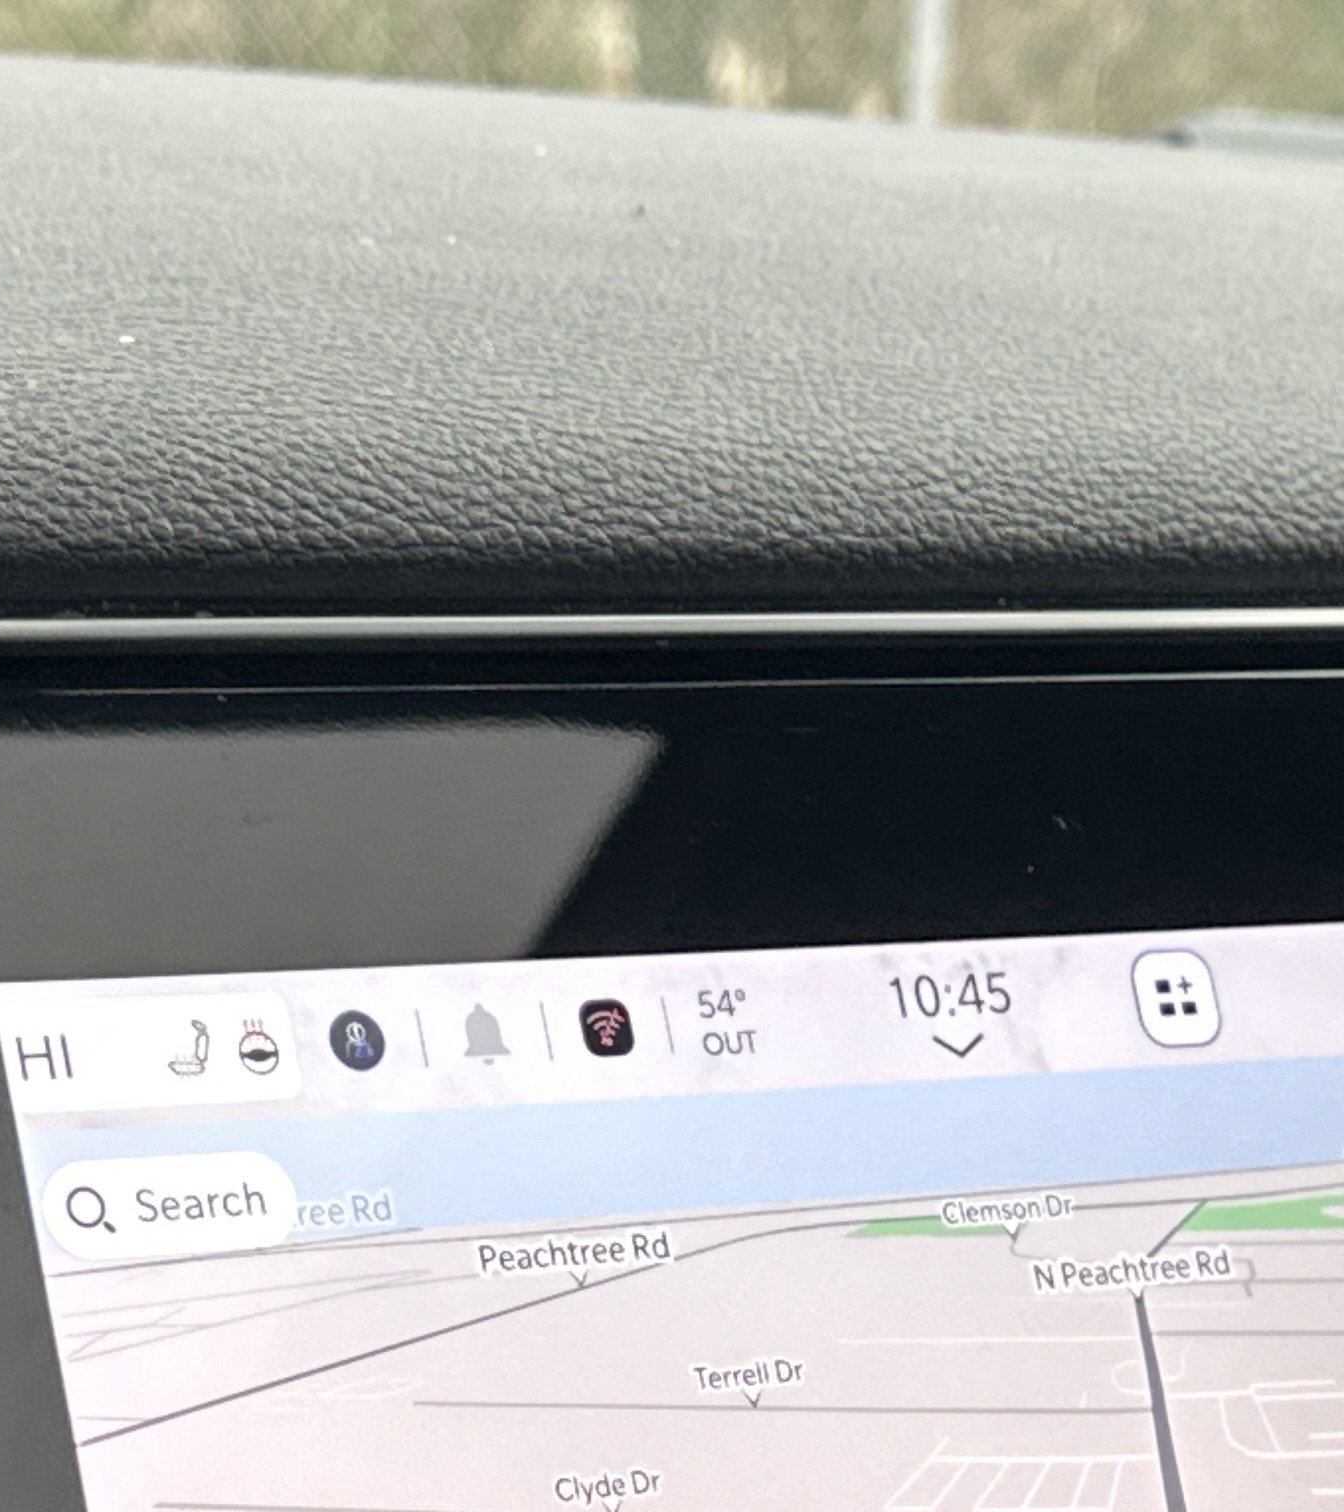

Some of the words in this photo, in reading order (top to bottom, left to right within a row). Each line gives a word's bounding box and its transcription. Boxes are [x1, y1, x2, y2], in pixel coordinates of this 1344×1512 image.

[889, 972, 1011, 1019] 10:45
[16, 1033, 75, 1081] HI
[702, 1029, 756, 1056] OUT
[136, 1181, 268, 1225] Search
[293, 1201, 345, 1228] ree
[351, 1193, 392, 1222] Rd
[942, 1201, 1039, 1225] Clemson
[1046, 1195, 1072, 1217] Dr
[478, 1237, 625, 1273] Peachtree
[632, 1232, 671, 1260] Rd
[1033, 1264, 1056, 1291] N
[1063, 1255, 1192, 1288] Peachtree
[1196, 1250, 1231, 1277] Rd
[693, 1361, 770, 1390] Terrell
[774, 1359, 804, 1384] Dr
[555, 1472, 626, 1505] Clyde
[630, 1470, 660, 1496] Dr
